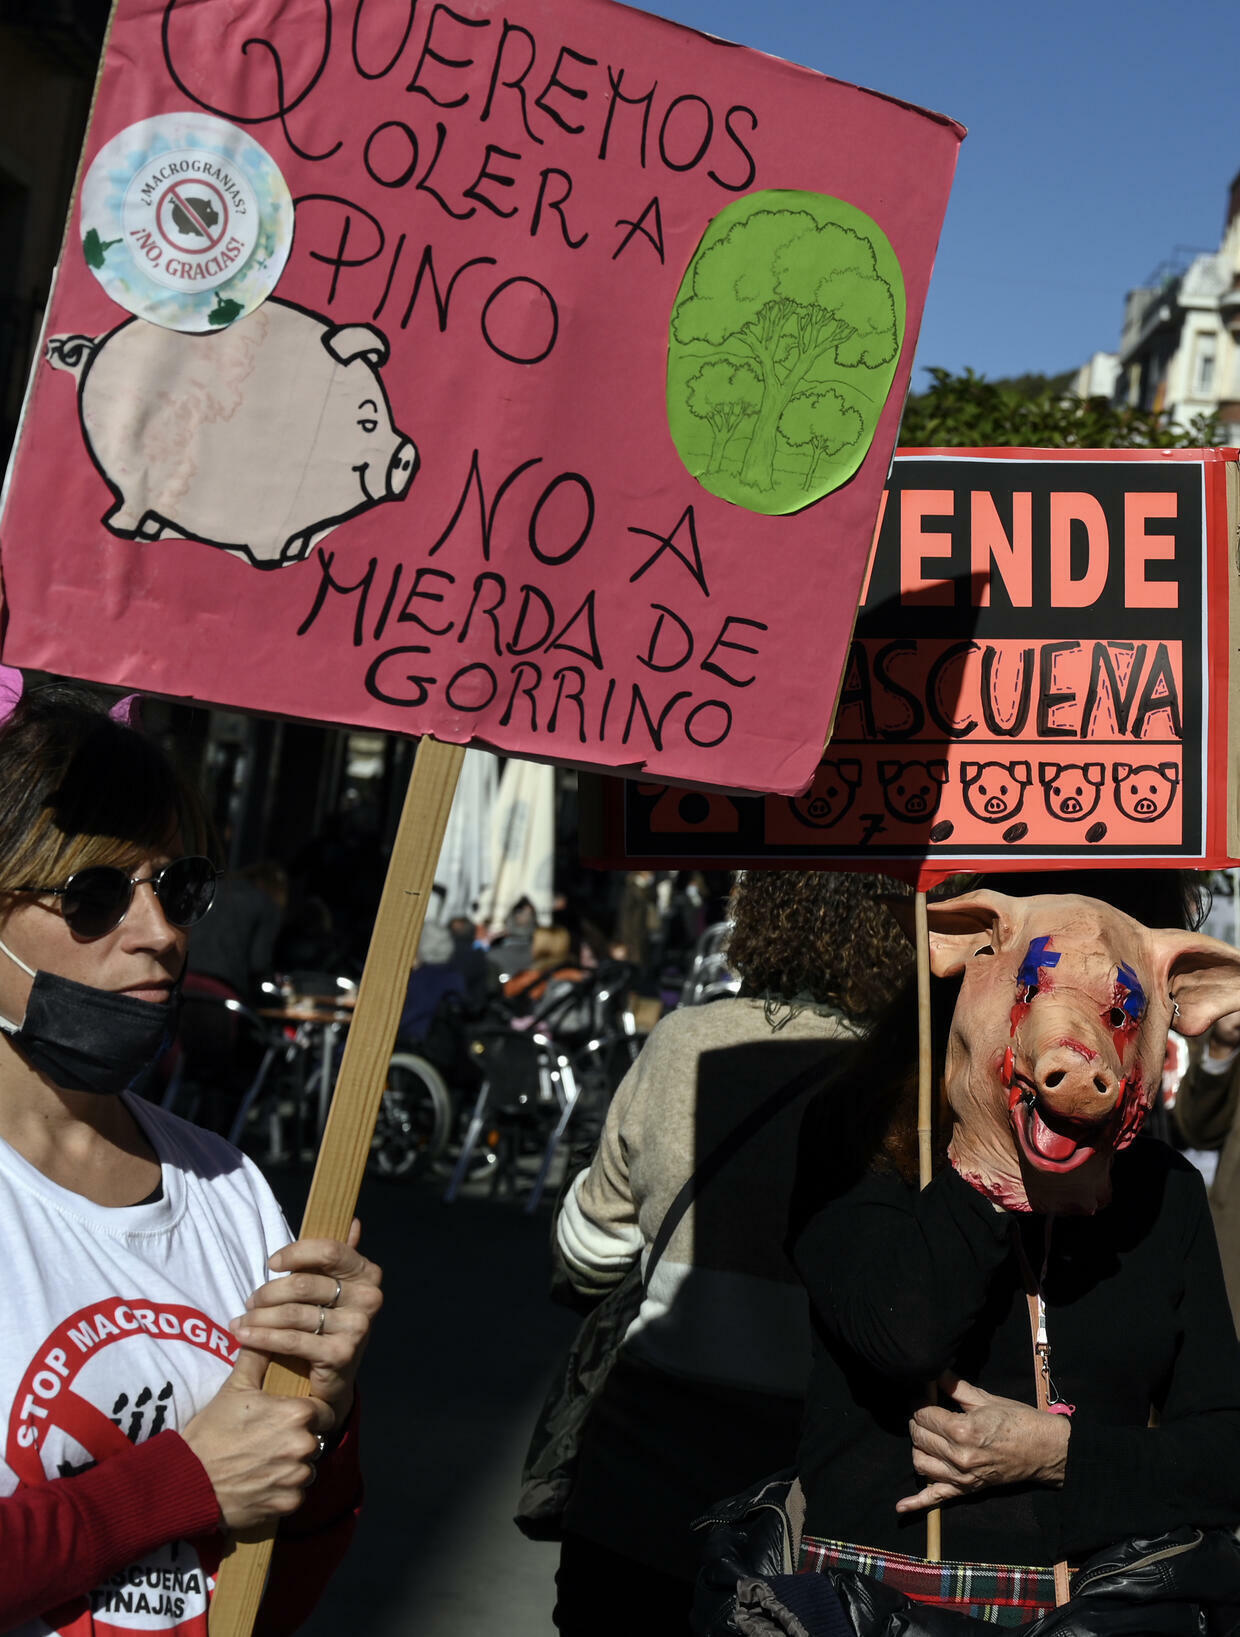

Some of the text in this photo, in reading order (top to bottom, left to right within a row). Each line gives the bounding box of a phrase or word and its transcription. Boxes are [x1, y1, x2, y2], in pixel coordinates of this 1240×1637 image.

[162, 0, 758, 192] QUEREMOS
[140, 160, 246, 215] ¿MACROGRANJAS?
[364, 121, 665, 265] OLER A
[130, 228, 245, 280] ¡NO, GRACIAS!
[293, 194, 559, 364] PINO
[429, 449, 710, 598] NO A
[859, 489, 1179, 608] ENDE
[297, 548, 769, 688] MIERDA DE
[364, 646, 734, 752] GORRINO
[16, 1347, 70, 1448] STOP
[90, 1590, 185, 1618] TINAJAS
